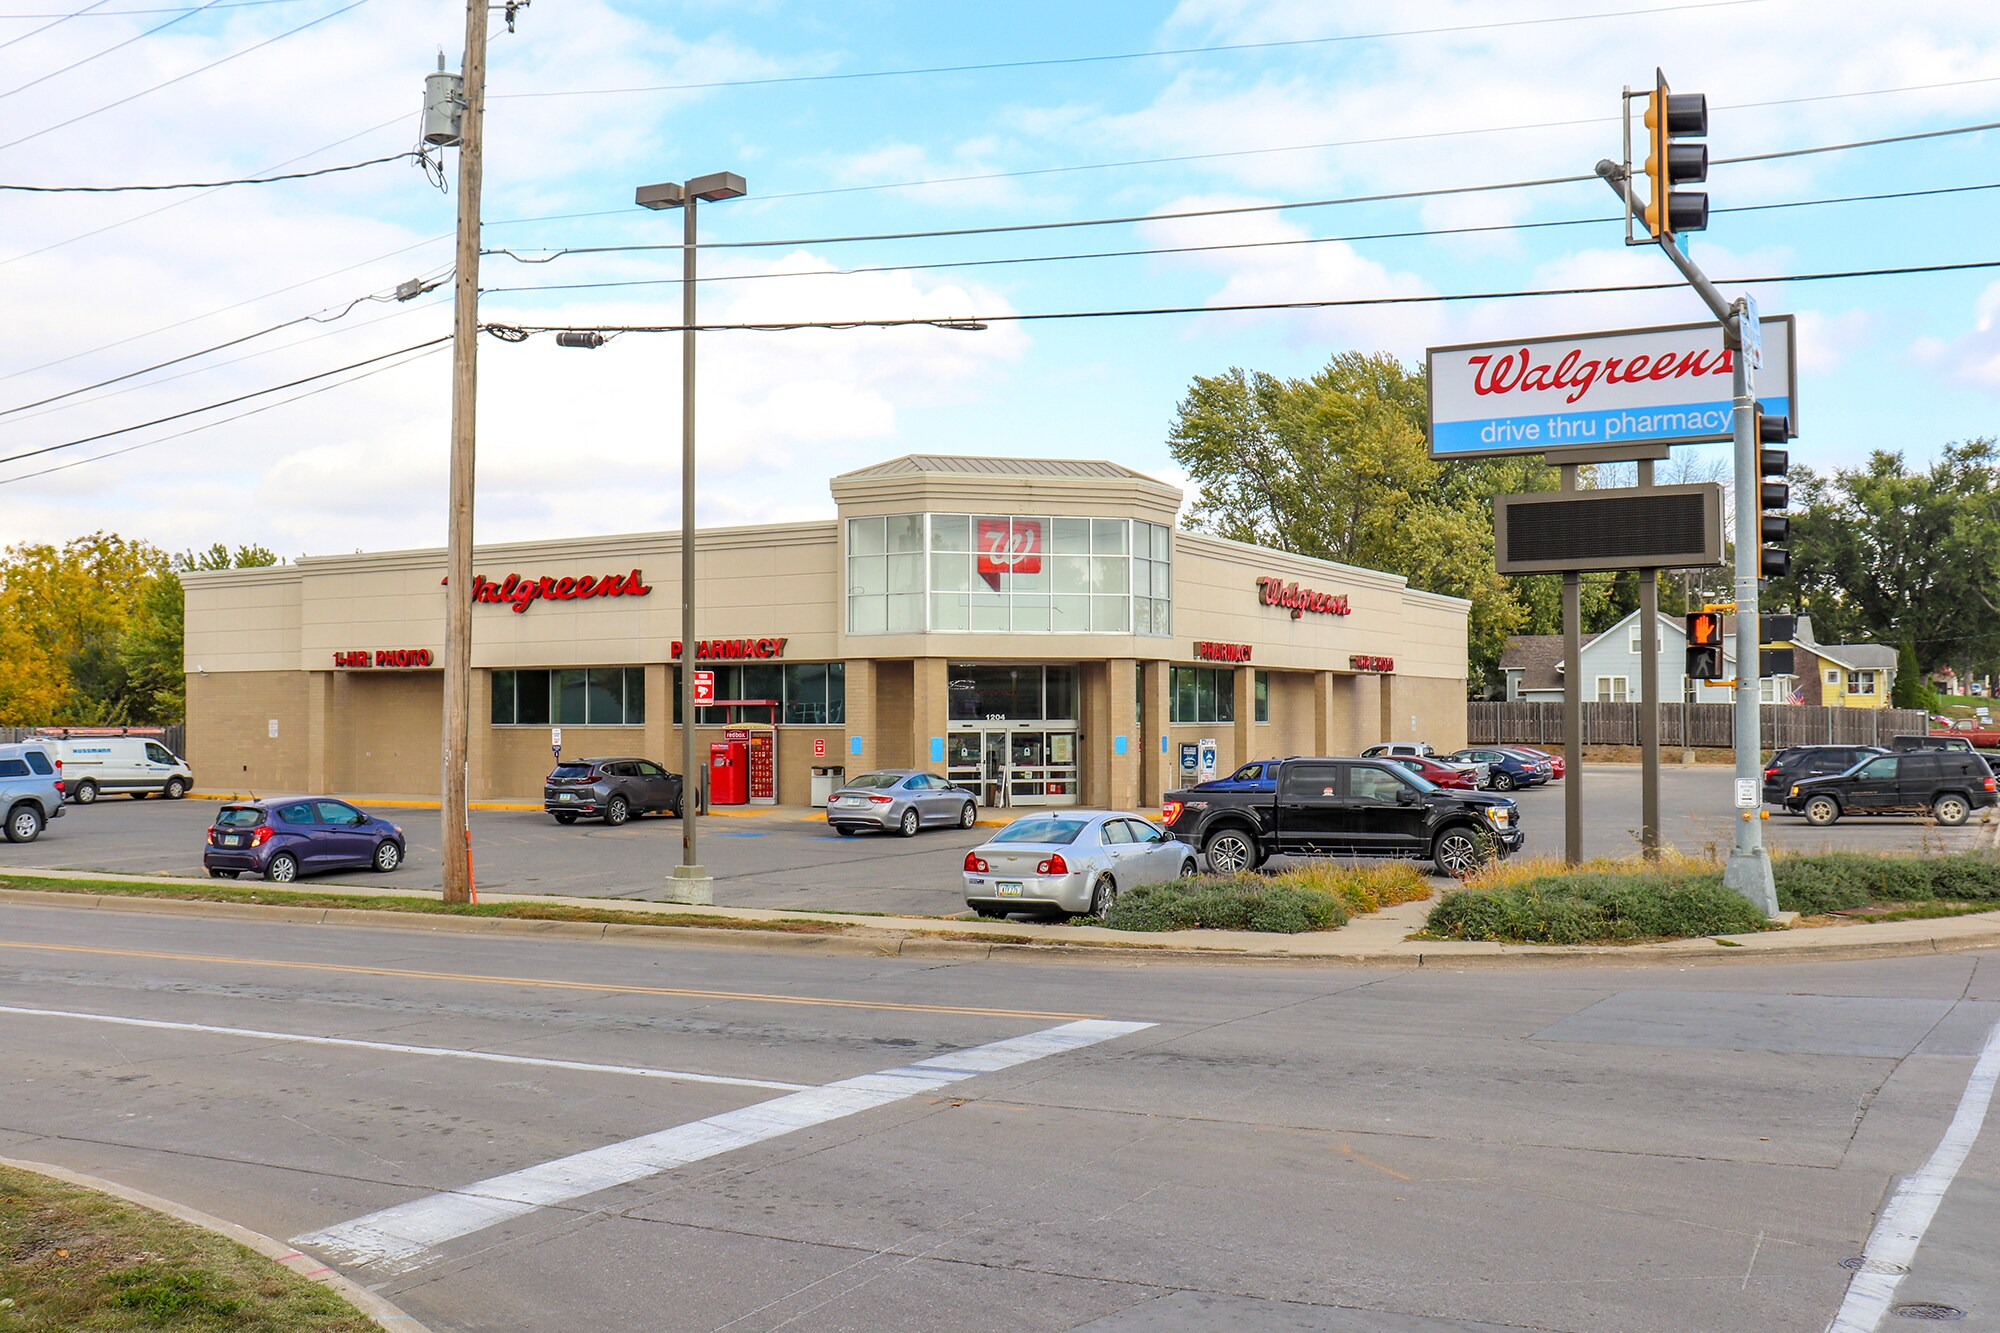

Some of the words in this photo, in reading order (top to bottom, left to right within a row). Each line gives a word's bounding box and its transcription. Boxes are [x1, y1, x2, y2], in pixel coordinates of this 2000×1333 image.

[1481, 421, 1540, 443] drive
[1548, 417, 1596, 439] thru
[1605, 408, 1734, 440] pharmacy
[1258, 576, 1351, 618] Walgreens
[333, 651, 370, 667] 1-HR
[376, 649, 433, 666] PHOTO
[671, 638, 787, 659] PARMACY
[1199, 641, 1252, 661] PHARMACY
